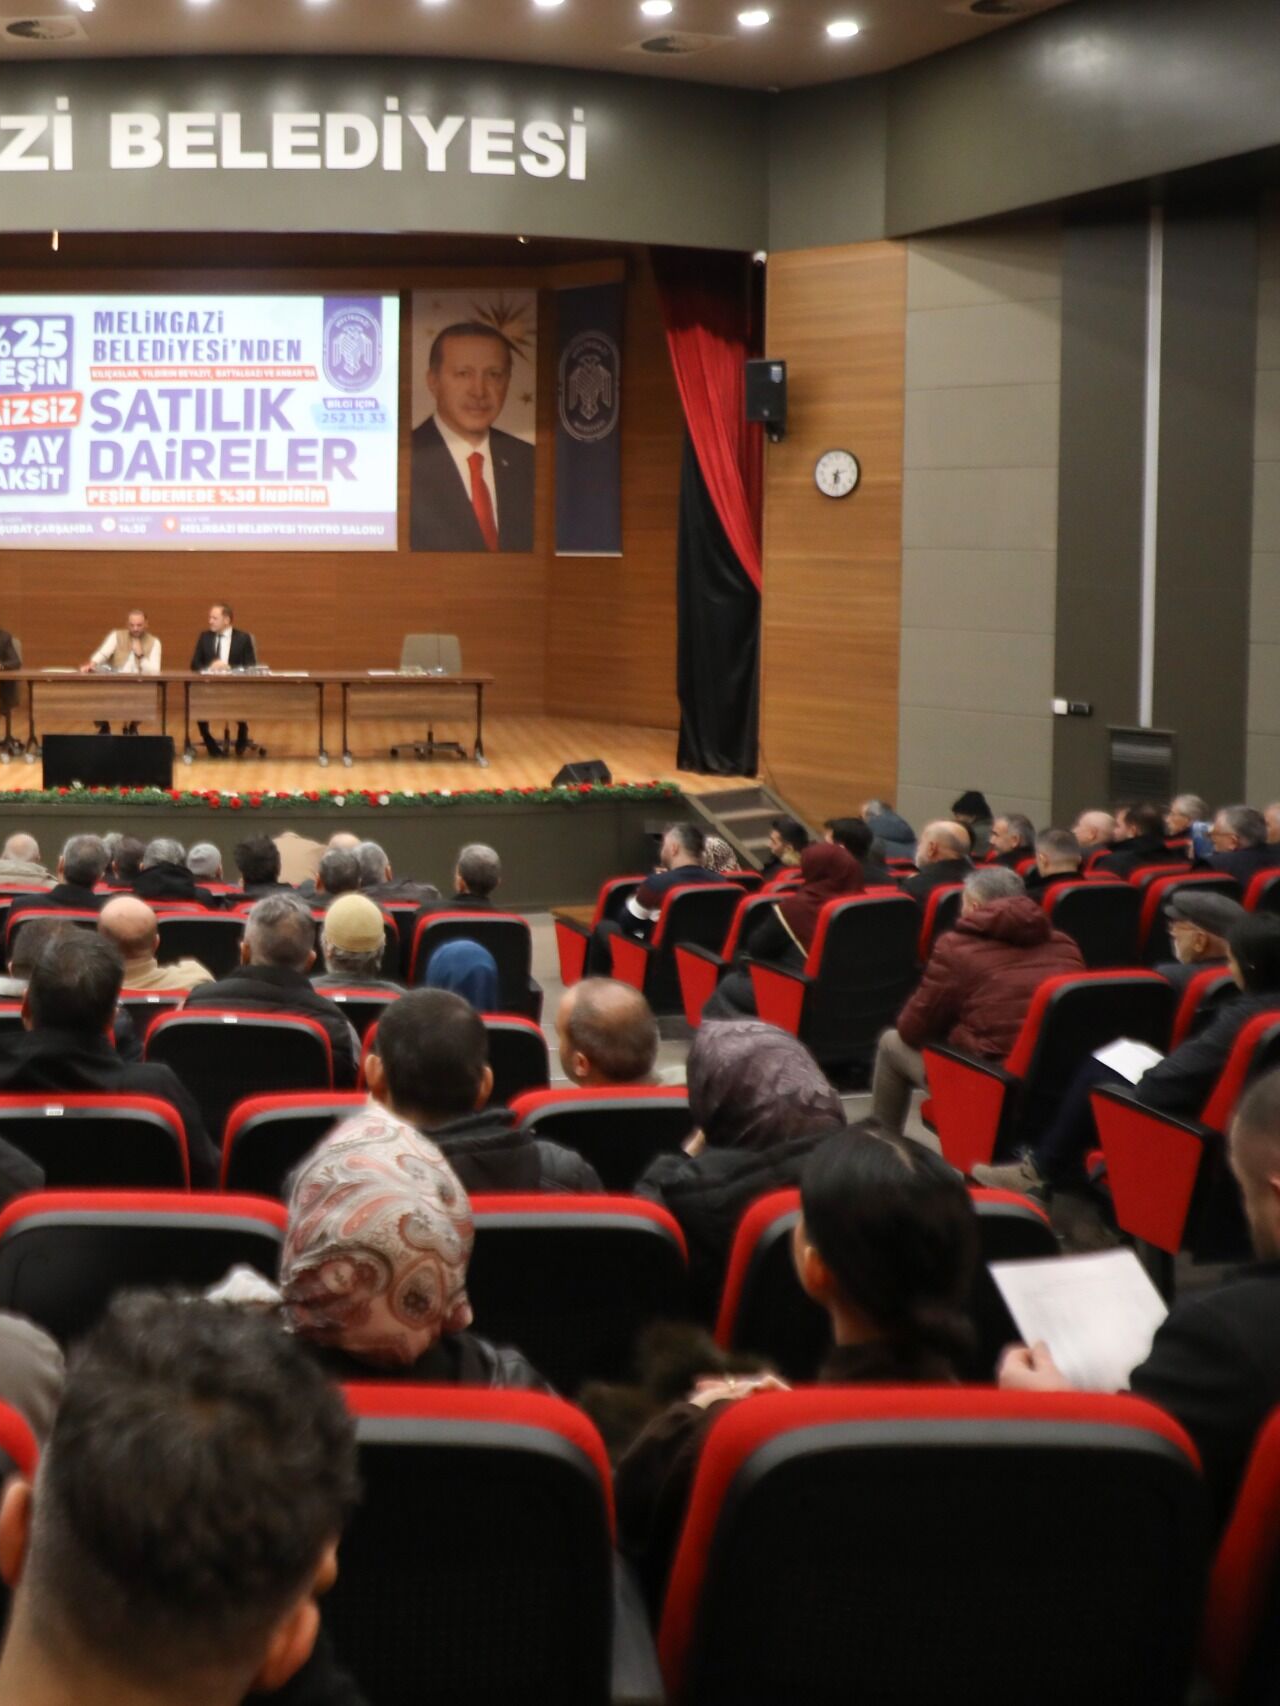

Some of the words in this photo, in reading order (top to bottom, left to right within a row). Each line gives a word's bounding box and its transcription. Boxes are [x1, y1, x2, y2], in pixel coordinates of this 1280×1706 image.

[109, 96, 589, 181] BELEDİYESİ
[93, 310, 224, 334] MELİKGAZİ
[93, 339, 302, 362] BELEDİYESİ'NDEN
[90, 388, 295, 433] SATILIK
[321, 413, 347, 424] 252
[21, 435, 65, 465] AY
[89, 438, 358, 481] DAİRELER
